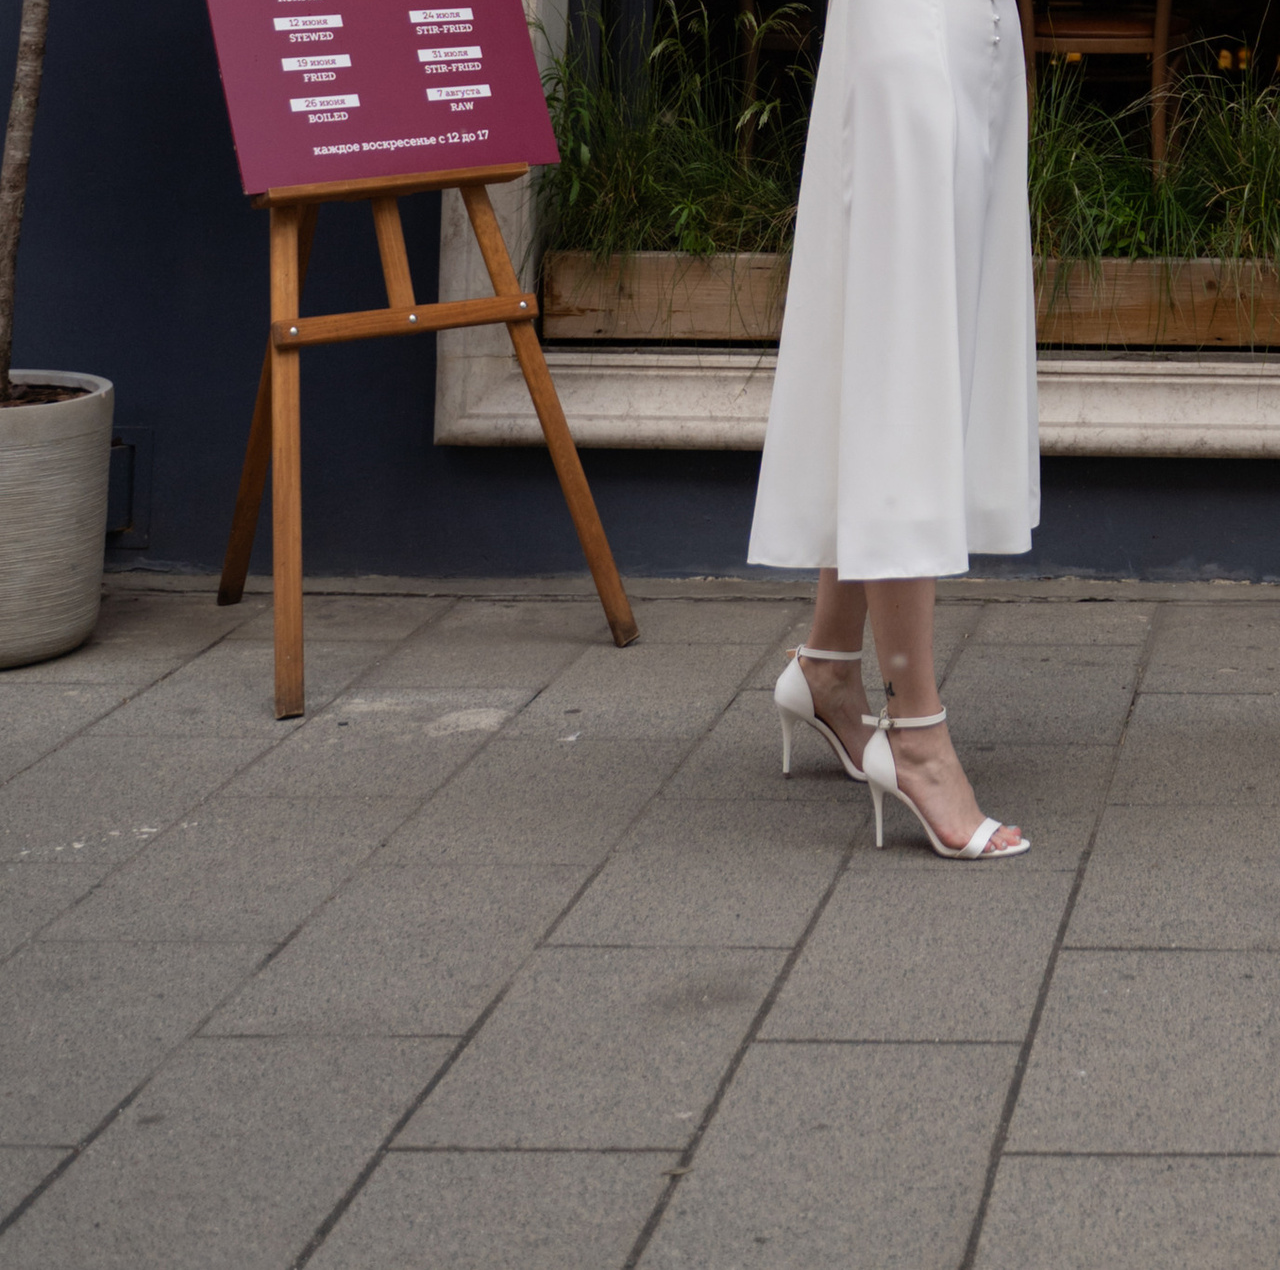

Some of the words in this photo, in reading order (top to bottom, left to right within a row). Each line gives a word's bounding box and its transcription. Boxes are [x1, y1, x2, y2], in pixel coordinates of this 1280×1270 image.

[289, 19, 299, 27] 12
[416, 24, 473, 35] STIR-FRIED
[289, 32, 334, 42] STEWED
[432, 50, 442, 58] 31
[444, 50, 468, 58] июля
[297, 59, 308, 67] 19
[310, 59, 337, 67] июня
[425, 62, 482, 74] STIR-FRIED
[303, 72, 336, 82] FRIED
[445, 89, 481, 98] августа
[305, 99, 317, 108] 26
[319, 99, 346, 107] июня
[450, 102, 474, 112] RAW
[308, 112, 348, 123] BOILED
[313, 143, 360, 155] каждое
[362, 135, 436, 151] воскресенье
[439, 135, 446, 144] с
[447, 131, 460, 142] 12
[462, 133, 476, 143] до
[477, 130, 489, 140] 17
